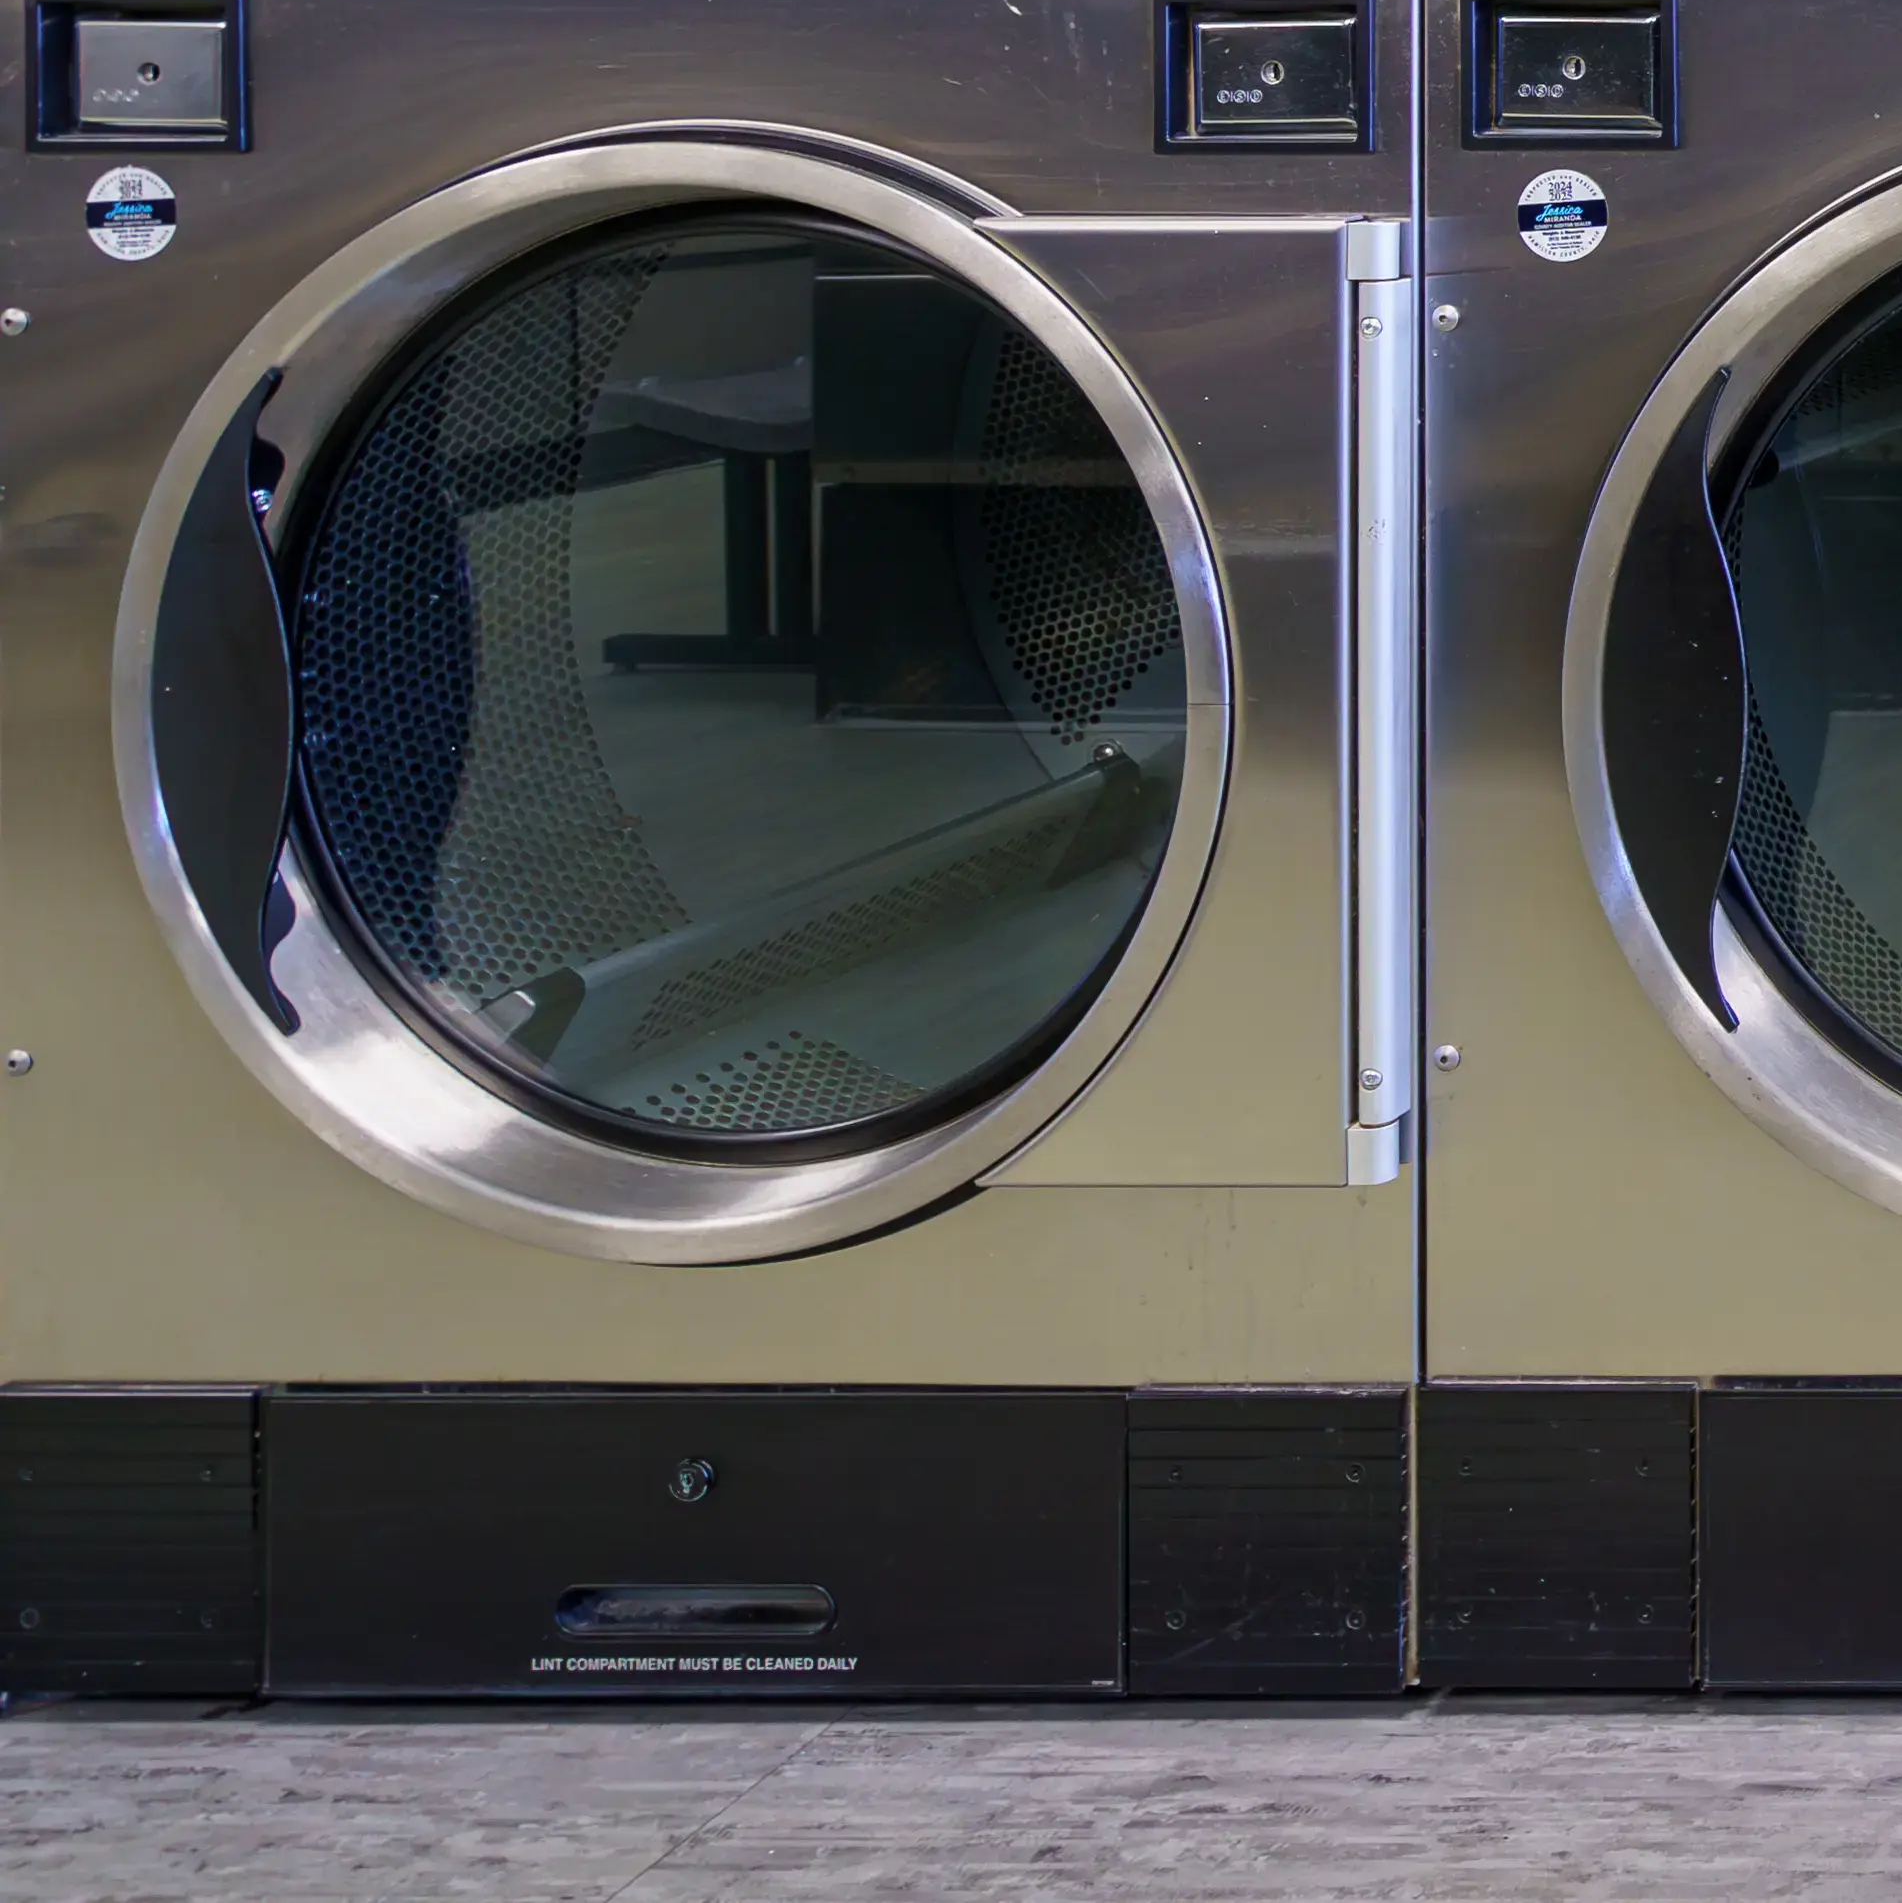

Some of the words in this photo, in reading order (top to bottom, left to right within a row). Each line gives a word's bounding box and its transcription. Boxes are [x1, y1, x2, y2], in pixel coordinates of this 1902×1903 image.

[1549, 182, 1572, 192] 2024
[1549, 192, 1572, 201] 2025
[1536, 205, 1583, 221] Jessica
[532, 1658, 563, 1670] LINT
[567, 1658, 675, 1671] COMPARTMENT
[679, 1658, 719, 1670] MUST
[723, 1658, 742, 1670] BE
[746, 1658, 813, 1670] CLEANED
[818, 1658, 857, 1670] DAILY
